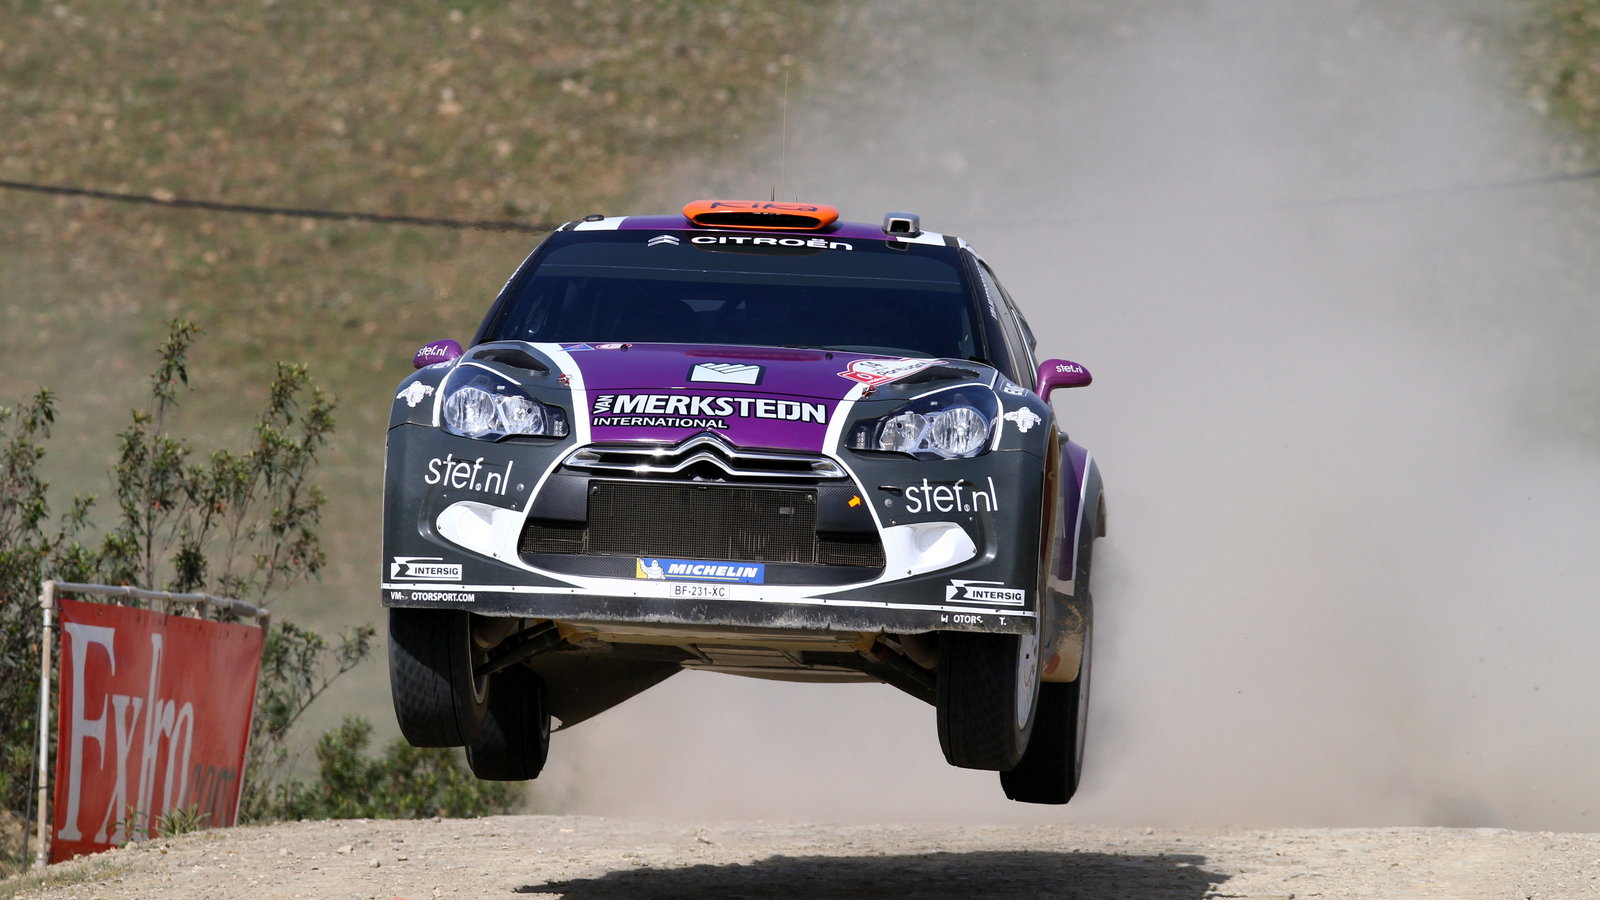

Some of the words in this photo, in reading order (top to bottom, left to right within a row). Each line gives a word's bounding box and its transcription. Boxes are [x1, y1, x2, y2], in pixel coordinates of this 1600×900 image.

[417, 345, 448, 357] stef.nl
[592, 395, 615, 415] VAN
[592, 417, 728, 429] INTERNATIONAL
[424, 453, 514, 496] stef.nl
[905, 476, 998, 513] stef.nl
[414, 567, 459, 575] INTERSIG
[667, 563, 758, 578] MICHELIN
[675, 585, 725, 597] BF-231-XC
[972, 590, 1022, 601] INTERSIG
